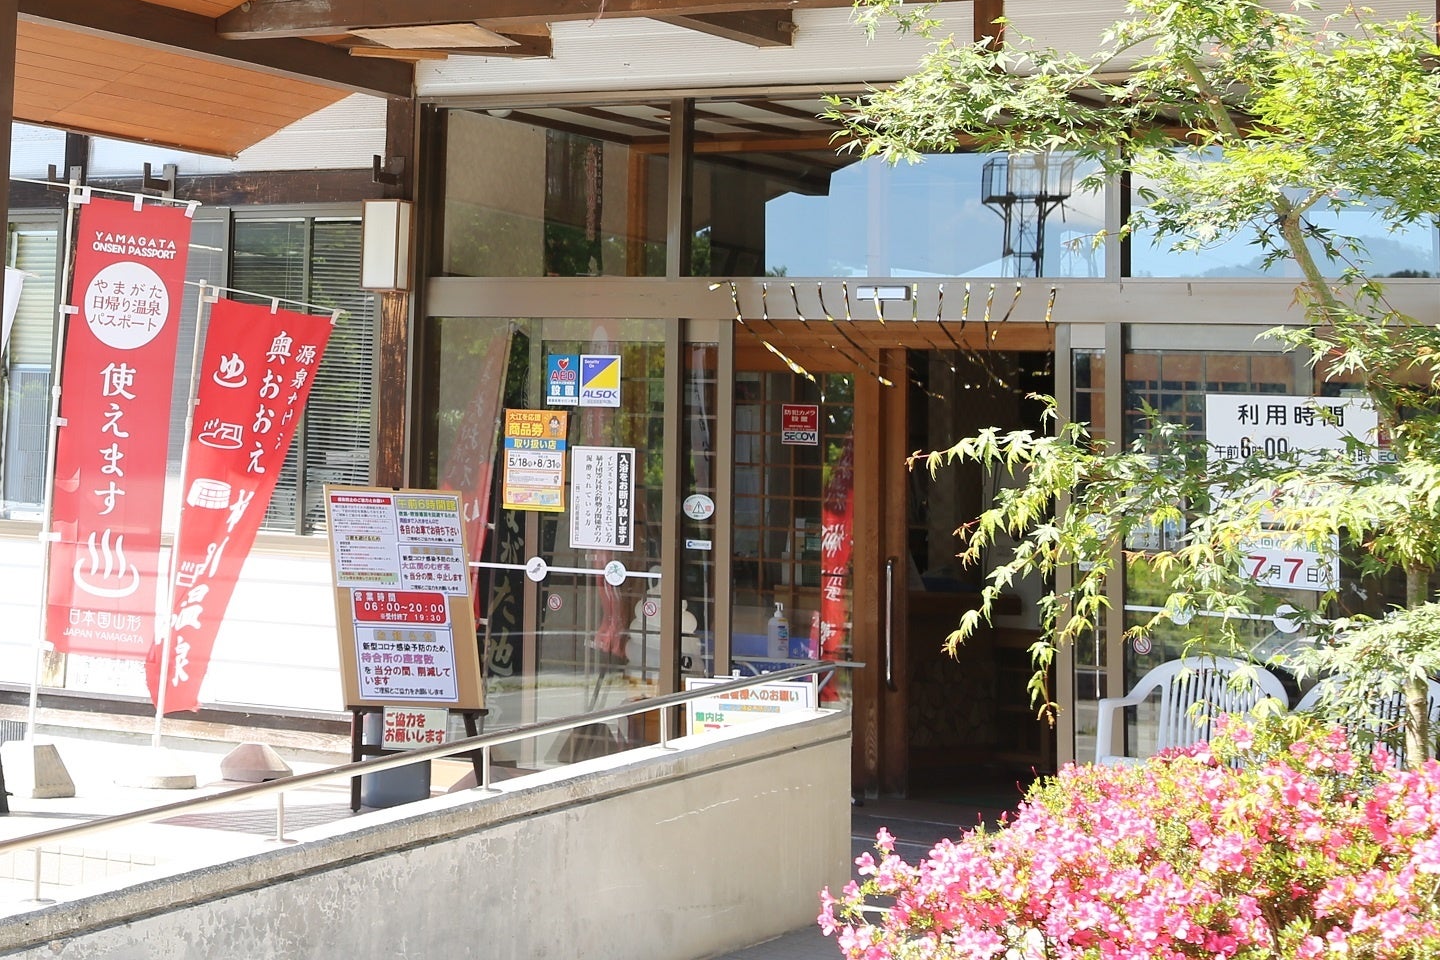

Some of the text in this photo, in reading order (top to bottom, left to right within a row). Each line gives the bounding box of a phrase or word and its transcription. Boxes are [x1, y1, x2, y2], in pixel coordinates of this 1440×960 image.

[95, 231, 176, 250] YAMAGATA
[92, 241, 177, 260] ONSEN PASSPORT
[94, 279, 163, 299] やまがた
[93, 295, 162, 316] 日帰り温泉
[89, 312, 158, 332] パスポート
[550, 369, 576, 382] AED
[551, 385, 575, 396] 設置
[582, 390, 618, 399] ALSOK
[1237, 404, 1345, 428] 利用時間
[509, 423, 544, 437] 商品券
[784, 431, 816, 441] SECOM
[94, 362, 137, 516] 使えます
[513, 439, 557, 450] 取り扱い店
[618, 454, 629, 544] 入浴をお断り致します
[354, 591, 397, 603] 営業時間
[69, 608, 142, 632] 日本国山形
[63, 627, 144, 644] JAPAN YAMAGATA
[361, 653, 435, 665] 待合所の座席数
[365, 676, 390, 686] います
[385, 711, 426, 728] ご協力を
[384, 728, 446, 745] お願いします
